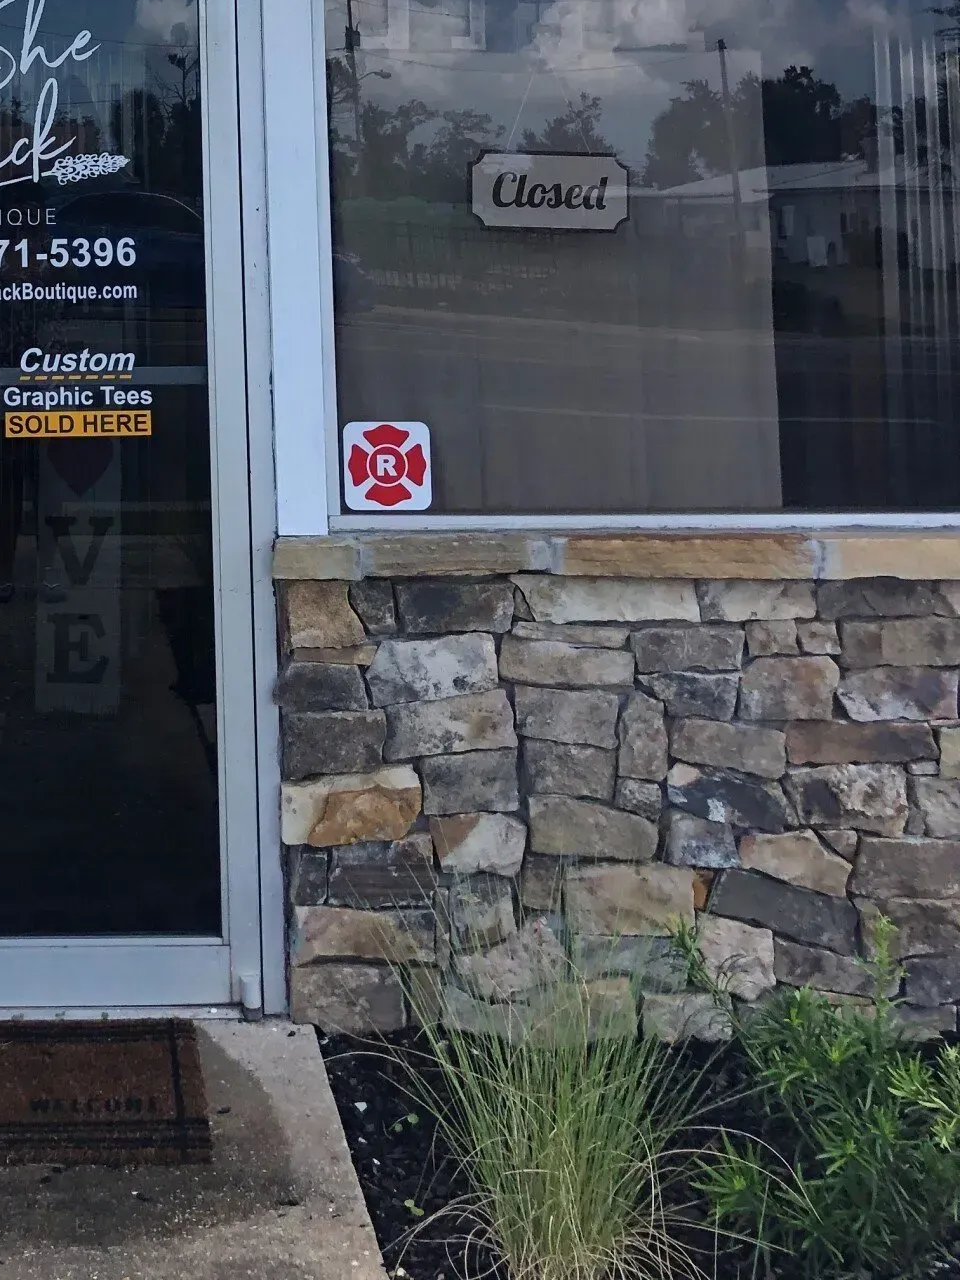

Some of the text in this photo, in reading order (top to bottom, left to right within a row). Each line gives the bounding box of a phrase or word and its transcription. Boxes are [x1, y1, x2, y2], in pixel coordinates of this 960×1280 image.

[492, 171, 608, 210] Closed
[19, 347, 135, 373] Custom
[3, 386, 153, 410] Graphic Tees
[8, 413, 149, 434] SOLD HERE
[377, 455, 398, 477] R
